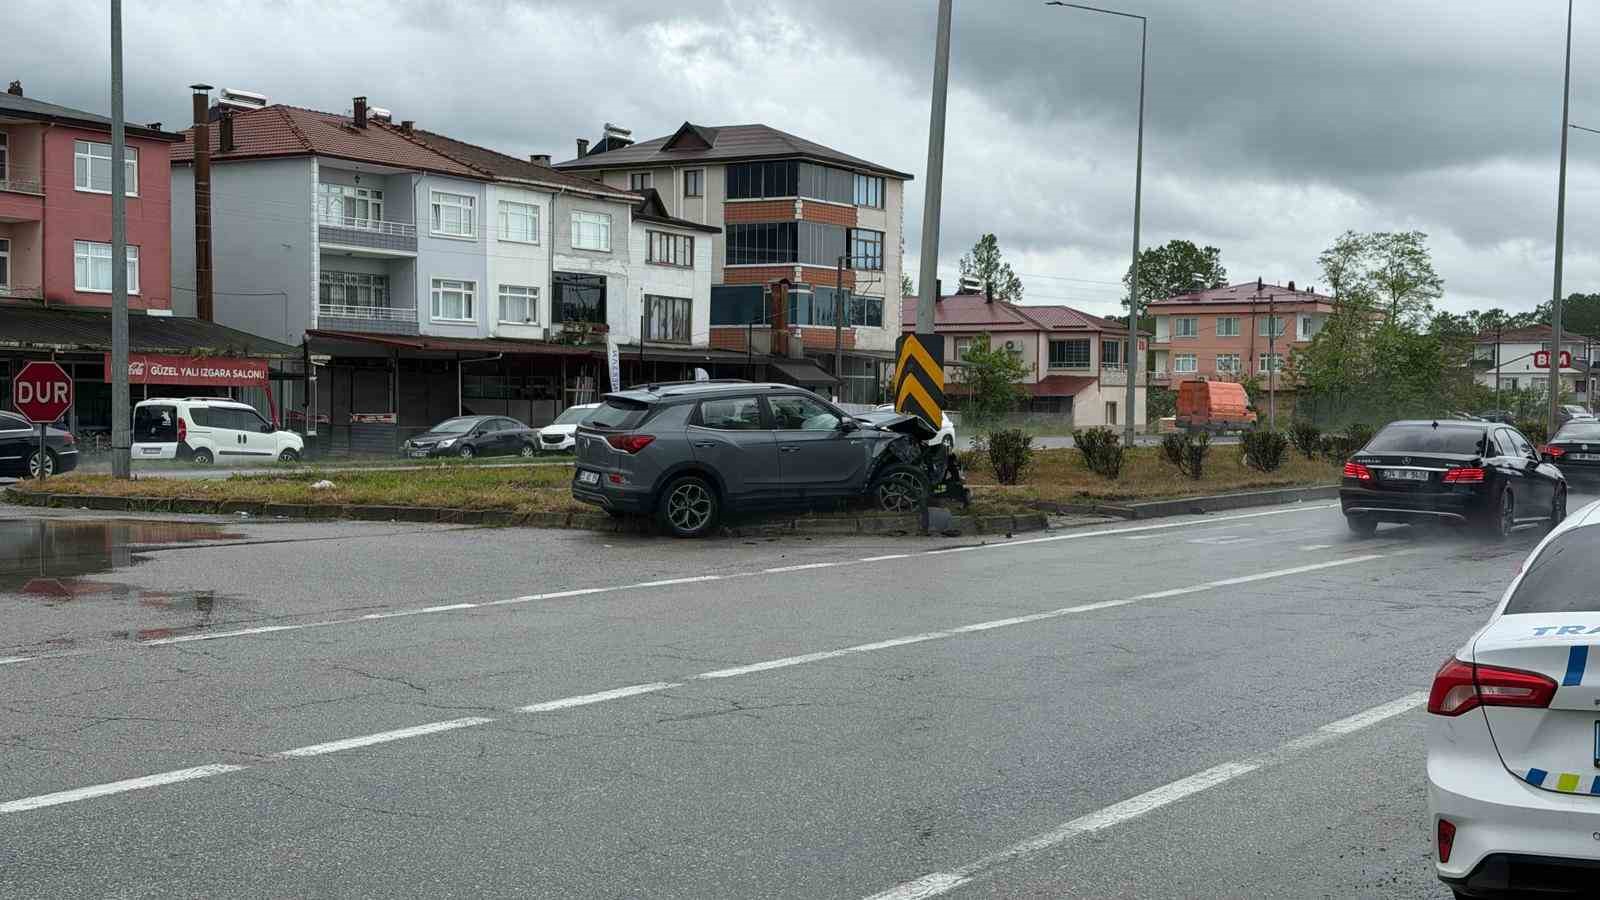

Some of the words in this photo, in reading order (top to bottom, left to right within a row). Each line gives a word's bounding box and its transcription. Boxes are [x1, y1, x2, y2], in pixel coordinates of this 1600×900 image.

[180, 367, 199, 377] YALI
[232, 368, 265, 379] SALONU
[18, 381, 68, 403] DUR
